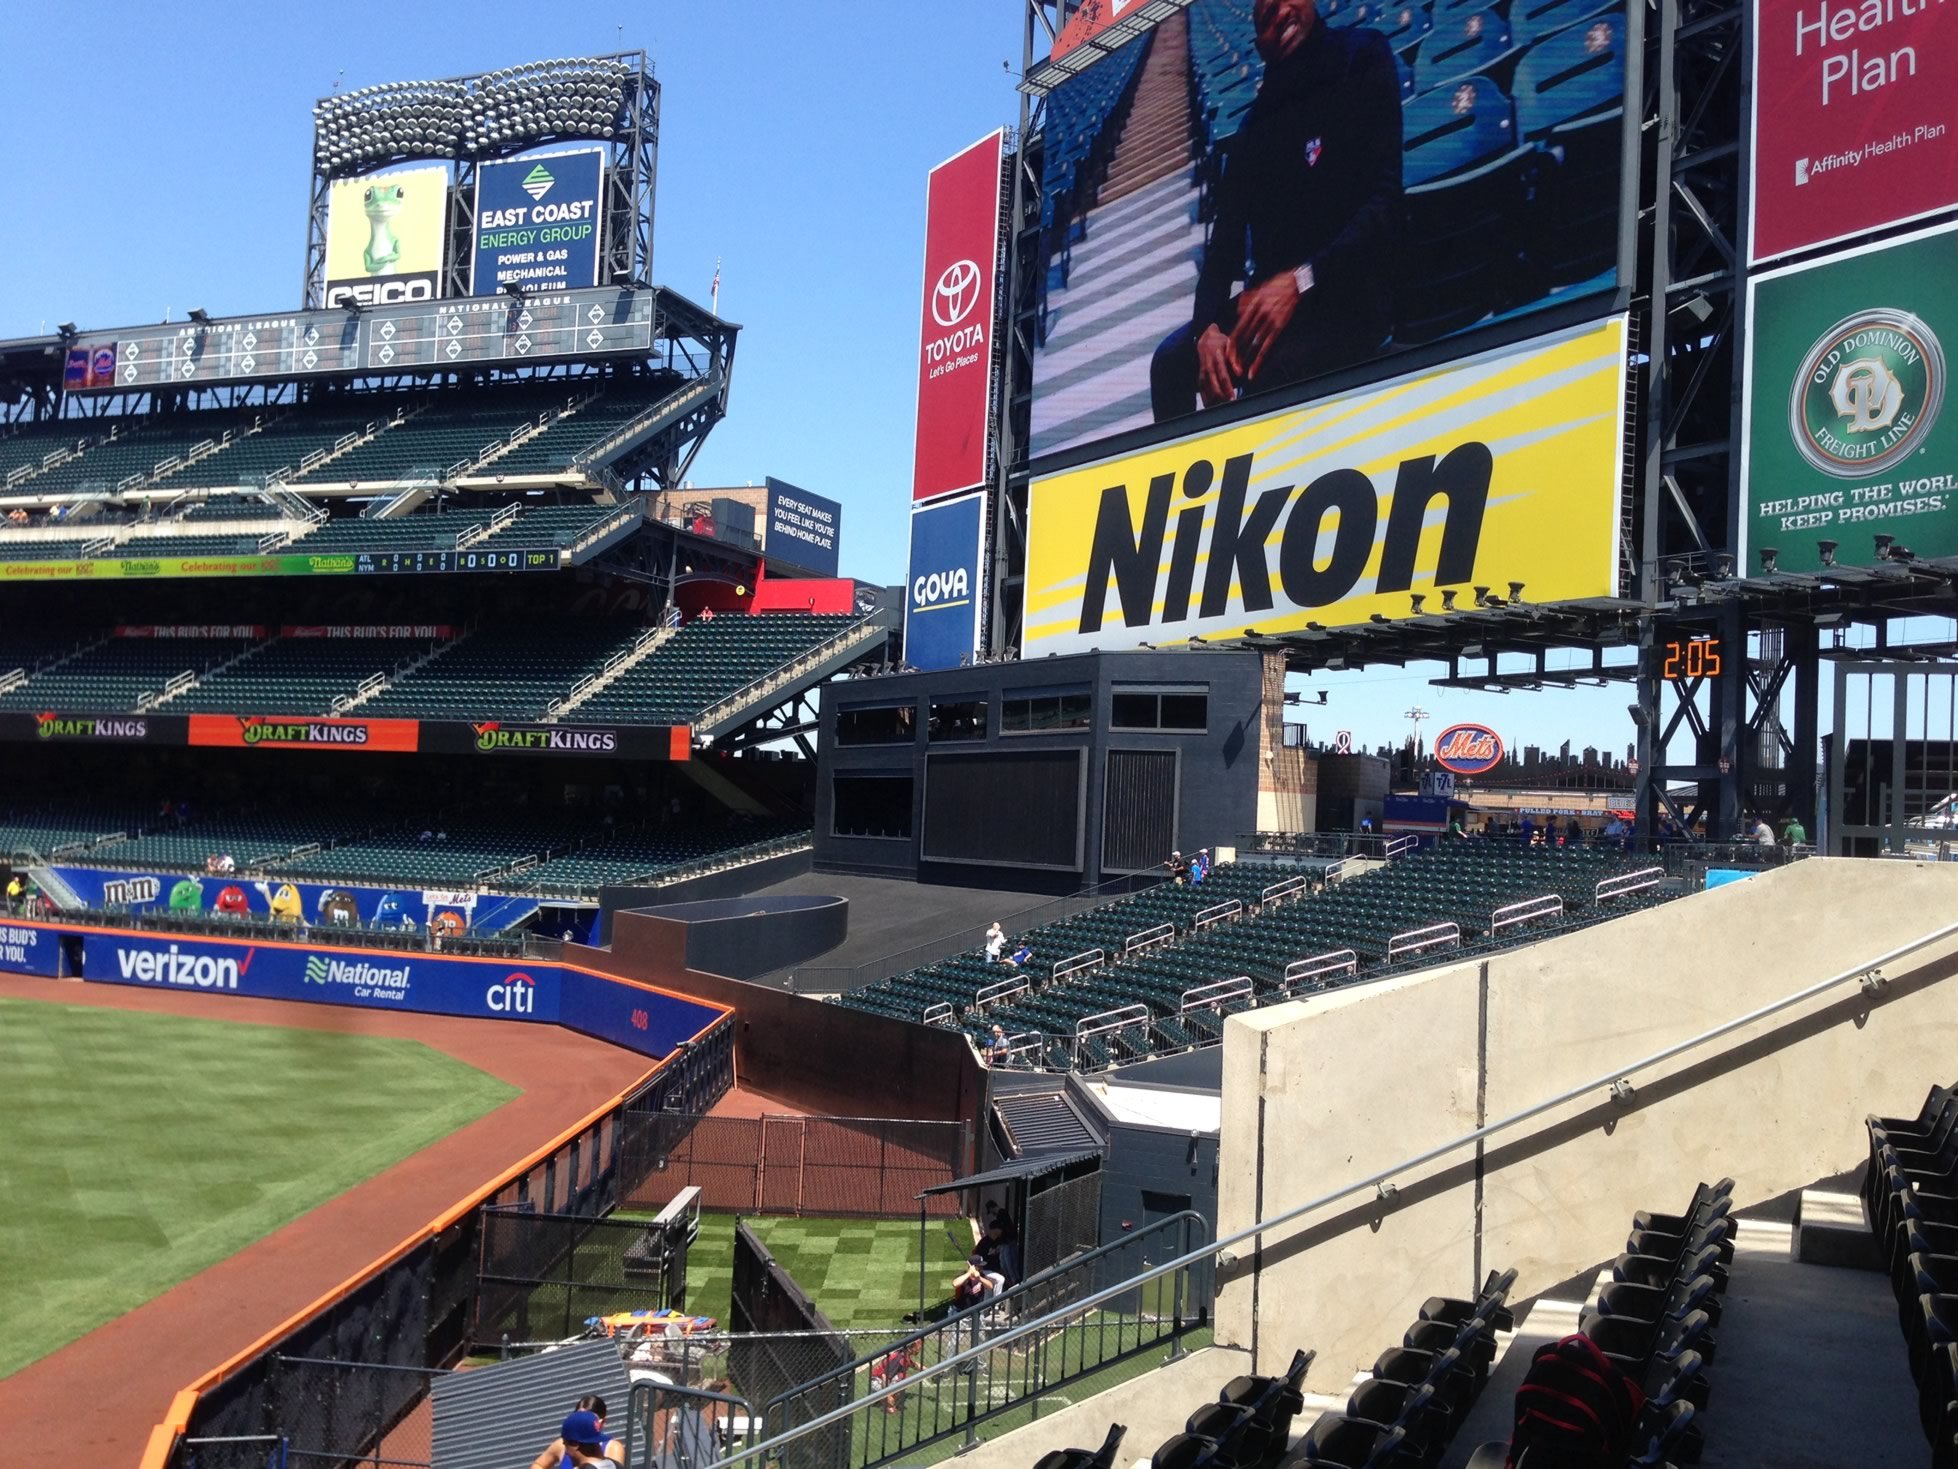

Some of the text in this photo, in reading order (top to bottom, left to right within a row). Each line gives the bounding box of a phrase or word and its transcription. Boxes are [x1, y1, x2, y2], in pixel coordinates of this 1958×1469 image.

[1796, 0, 1944, 56] Hea
[1822, 46, 1916, 106] Plan
[1810, 124, 1945, 176] Affinity Health Plan
[481, 200, 594, 229] EAST COAST
[480, 225, 592, 249] ENERGY GROUP
[498, 249, 568, 265] POWER & GAS
[497, 266, 567, 281] MECHANICAL
[327, 279, 432, 309] GEICO
[496, 281, 567, 294] POLEUM
[439, 296, 571, 314] NATIONAL LEAGUE
[179, 319, 296, 336] AMICAN LEAGUE
[926, 323, 984, 364] TOYOTA
[929, 352, 979, 380] Let's Go Places
[1814, 331, 1920, 384] OLD DOMINION
[1815, 412, 1915, 458] FREIGHT LINE
[778, 495, 833, 524] EVERY SEAT MAKES
[1759, 491, 1844, 517] HELPING
[1850, 483, 1892, 504] THE
[774, 507, 835, 538] YOU FEEL LIKE YOU'RE
[1780, 495, 1947, 531] KEEP PROMISES.
[774, 521, 797, 537] BEHIND
[796, 528, 815, 544] HOME
[1078, 441, 1494, 634] Nikon
[181, 560, 237, 575] Celebrating
[240, 563, 257, 571] our
[309, 556, 354, 569] Nathan's
[358, 553, 446, 563] ATL 0 0 0
[358, 563, 446, 572] NYM 0 0 0
[467, 555, 476, 568] 0
[487, 554, 496, 567] 0
[508, 553, 517, 567] 0
[527, 554, 554, 564] TOP 1
[5, 564, 55, 576] Celebrating
[57, 567, 72, 575] our
[914, 568, 968, 607] GOYA
[1664, 639, 1720, 678] 2:05
[38, 719, 146, 738] DRAFTKINGS
[243, 723, 367, 744] DRAFTKINGS
[476, 729, 616, 751] DRAFTKINGS
[1440, 730, 1497, 761] Mets
[449, 894, 472, 905] Mets
[9, 927, 37, 947] BUD'S
[5, 945, 27, 963] YOU.
[117, 944, 239, 989] verizon
[326, 960, 409, 988] National
[354, 986, 405, 1000] Car Rental
[486, 979, 533, 1013] citi
[631, 1008, 648, 1031] 408
